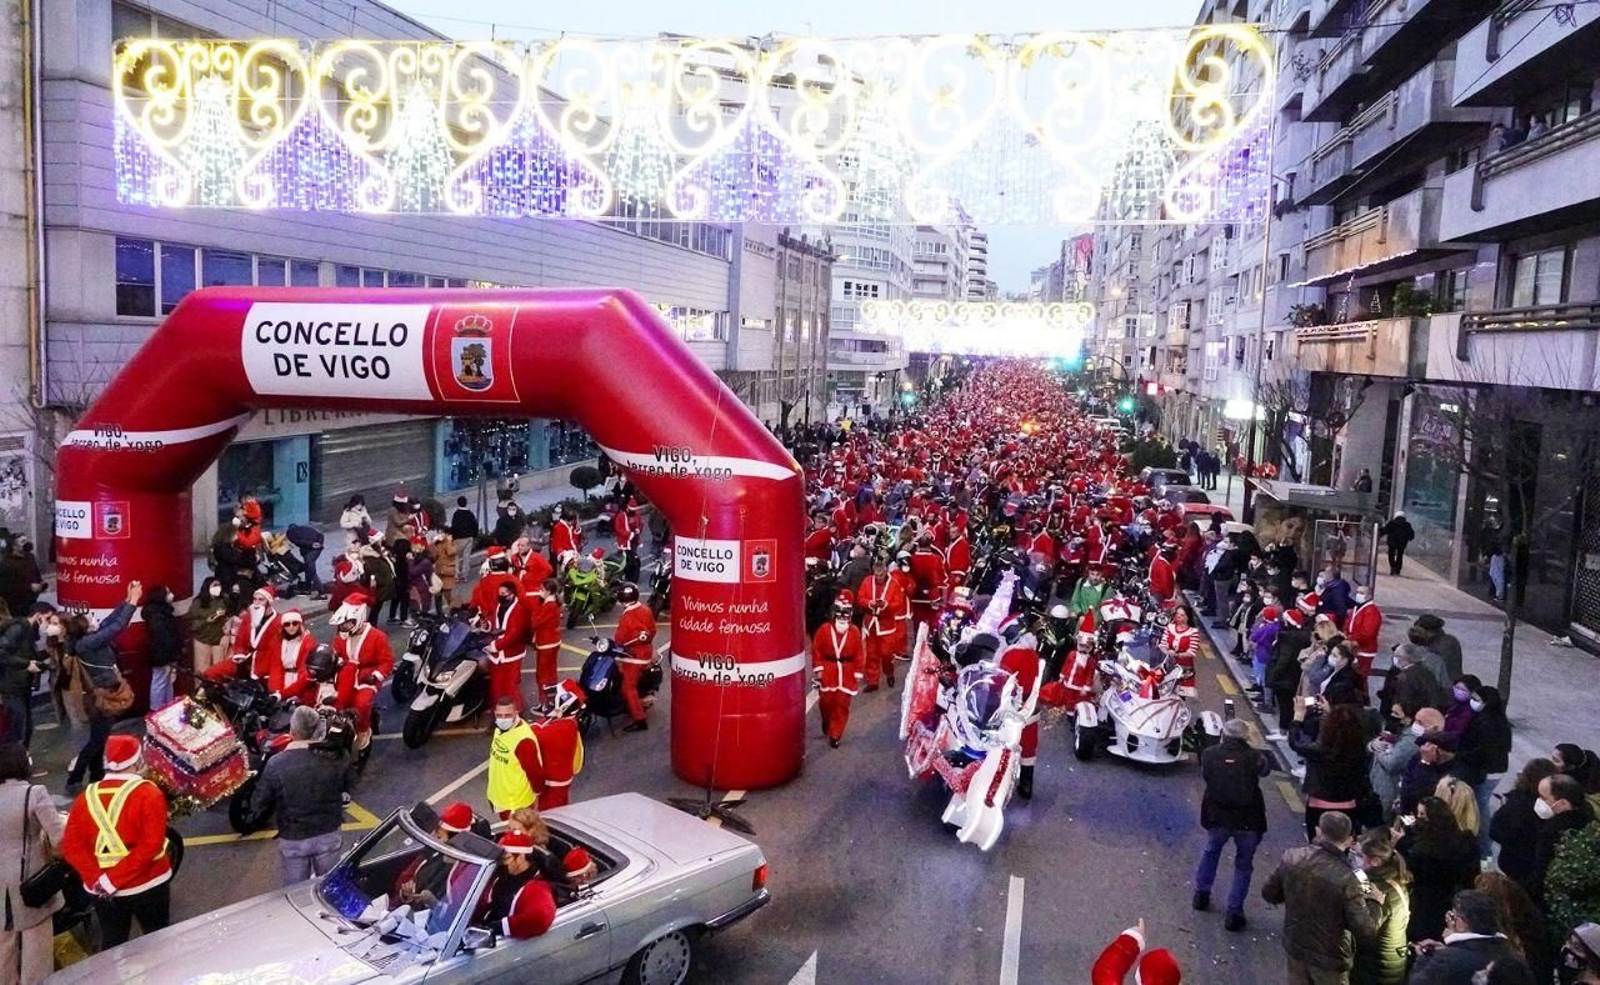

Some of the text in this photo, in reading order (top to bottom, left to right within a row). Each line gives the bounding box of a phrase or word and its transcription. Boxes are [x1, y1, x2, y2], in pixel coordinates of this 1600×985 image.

[256, 320, 408, 347] CONCELLO
[273, 353, 390, 380] DE VIGO
[105, 438, 121, 451] de
[126, 440, 163, 454] xogo
[670, 463, 688, 479] de
[694, 465, 733, 482] xogo
[677, 544, 734, 560] CONCELLO
[80, 554, 119, 568] nunha
[681, 559, 725, 573] DE VIGO
[74, 569, 121, 585] fermosa
[682, 595, 769, 614] Vivimos nunha
[680, 616, 771, 635] cidade fermosa
[713, 670, 731, 686] de
[737, 670, 775, 687] xogo
